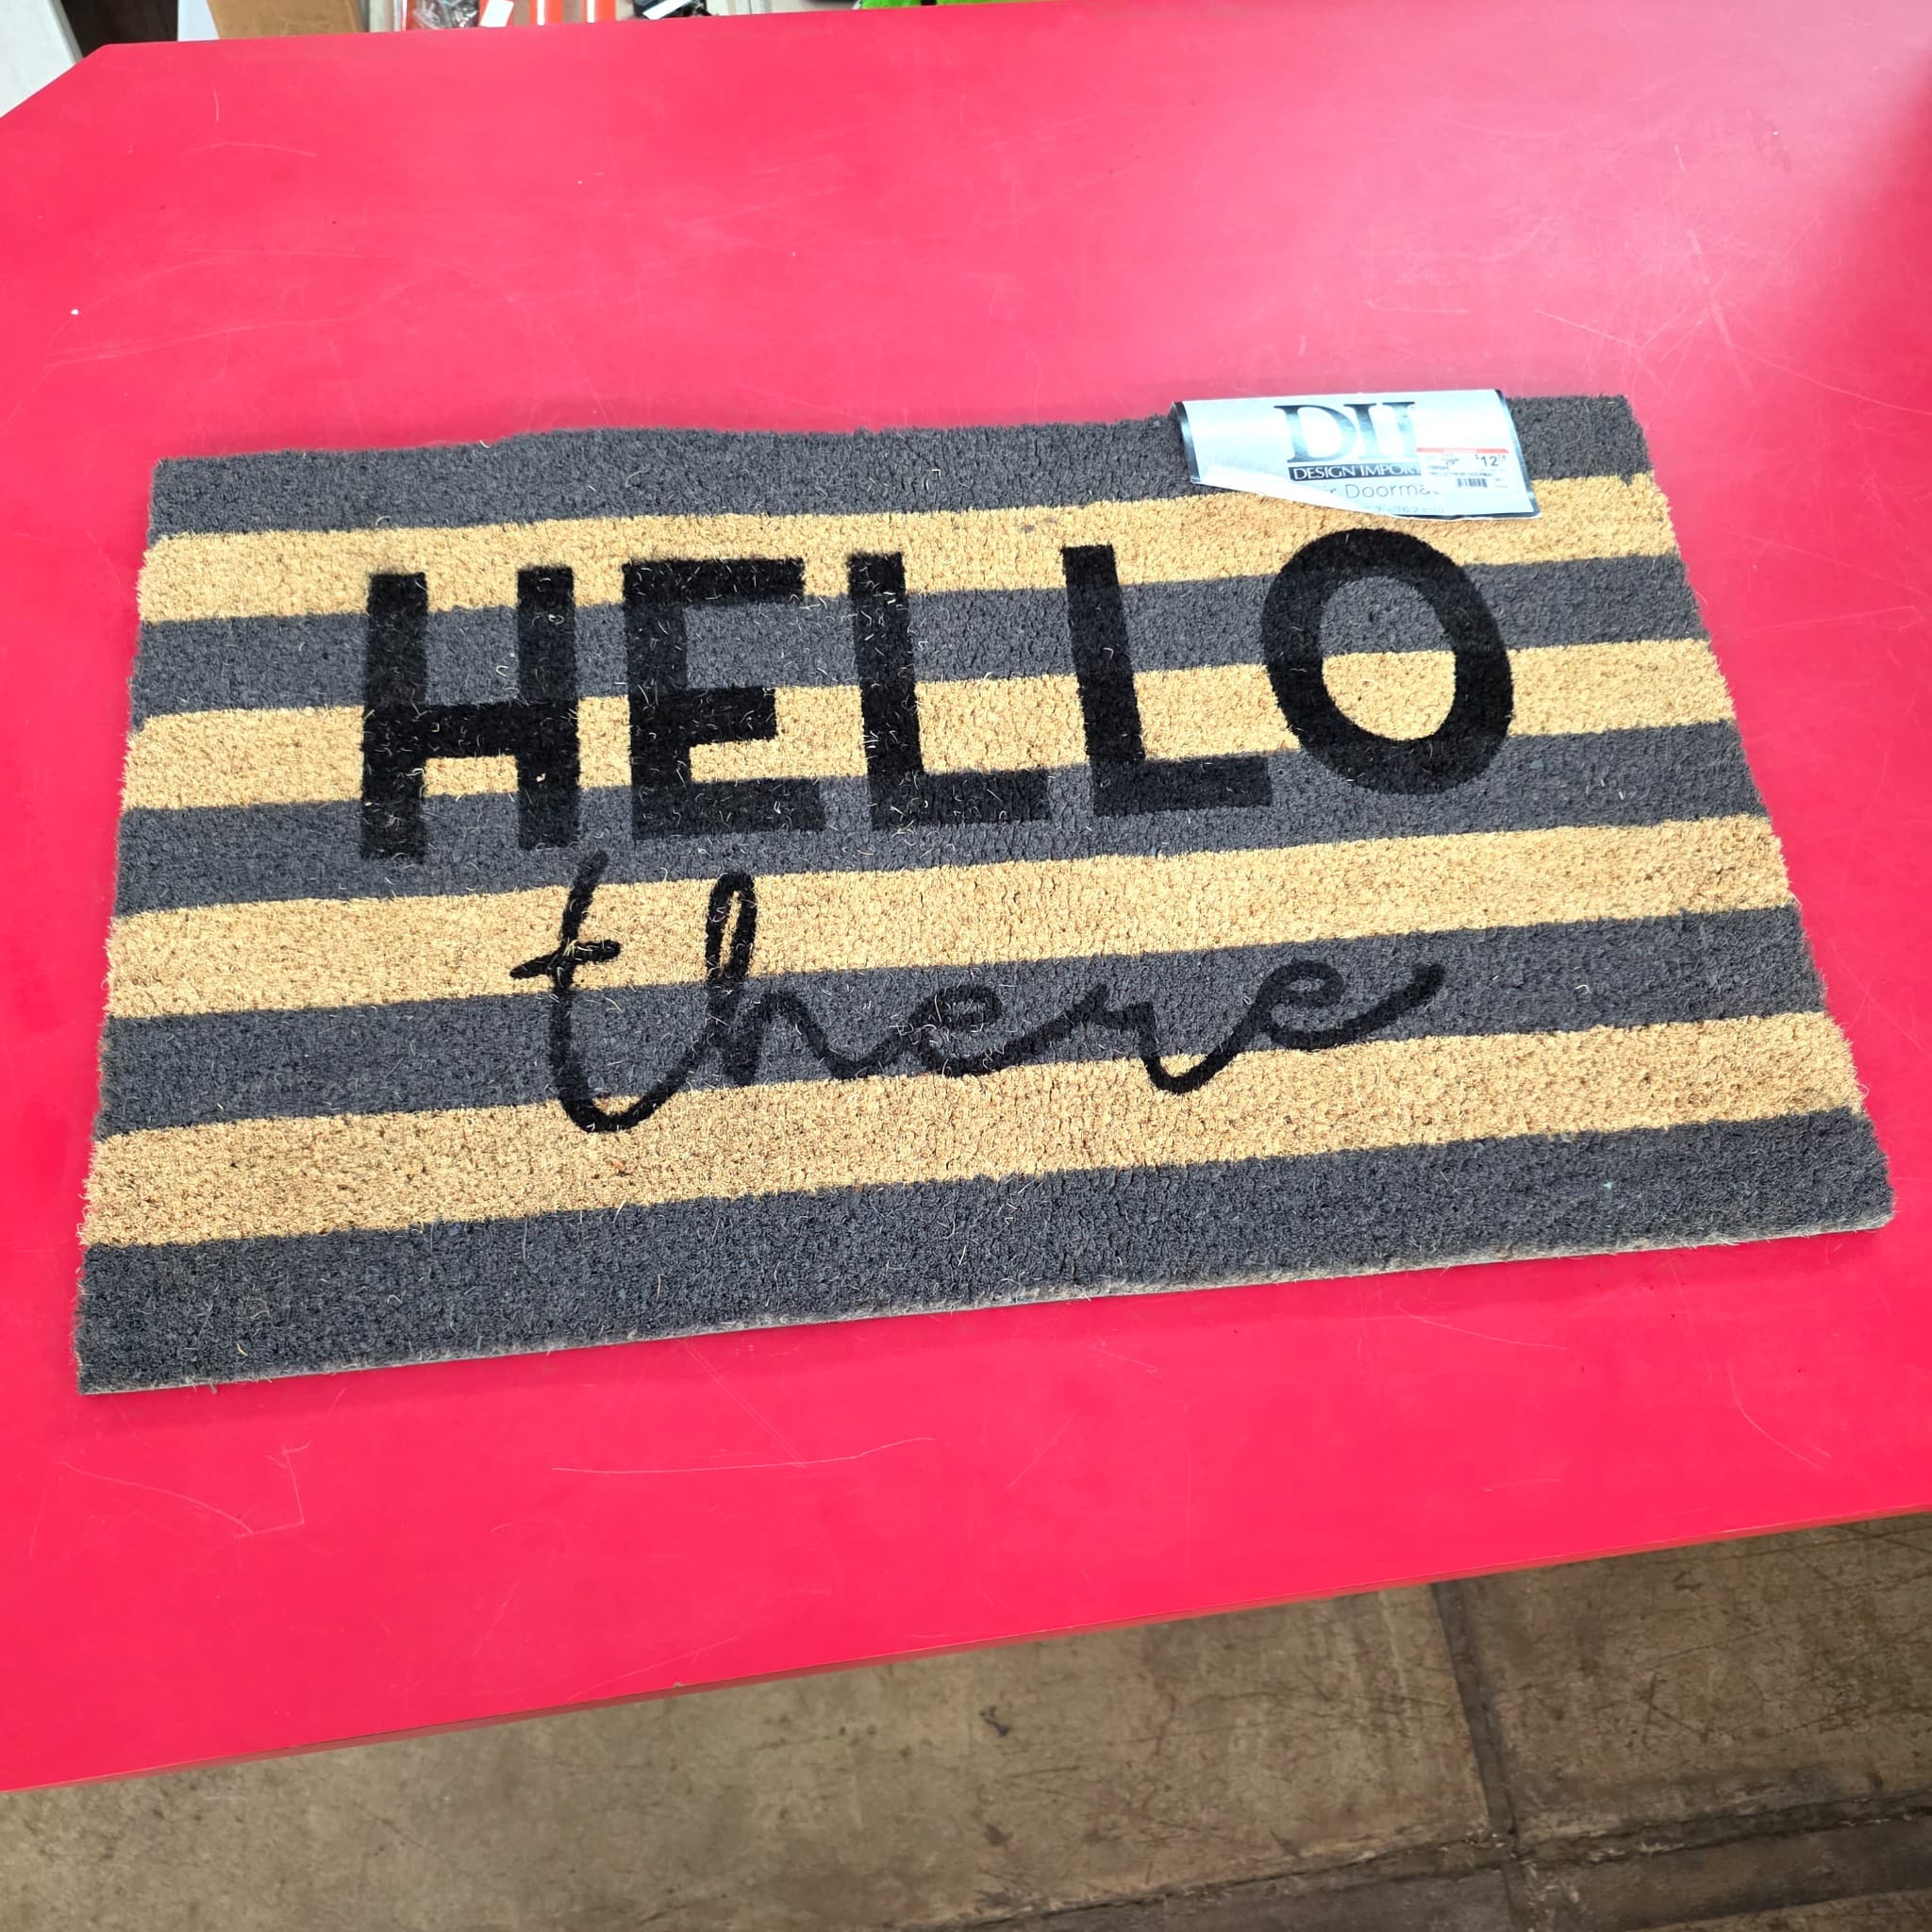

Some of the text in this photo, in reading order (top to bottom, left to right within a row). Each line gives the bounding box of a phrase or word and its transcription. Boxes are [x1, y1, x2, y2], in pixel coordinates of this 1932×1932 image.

[1292, 465, 1356, 480] DESIGN
[1344, 483, 1441, 499] Doorma
[361, 527, 1514, 861] HELLO
[510, 851, 1445, 1132] there
